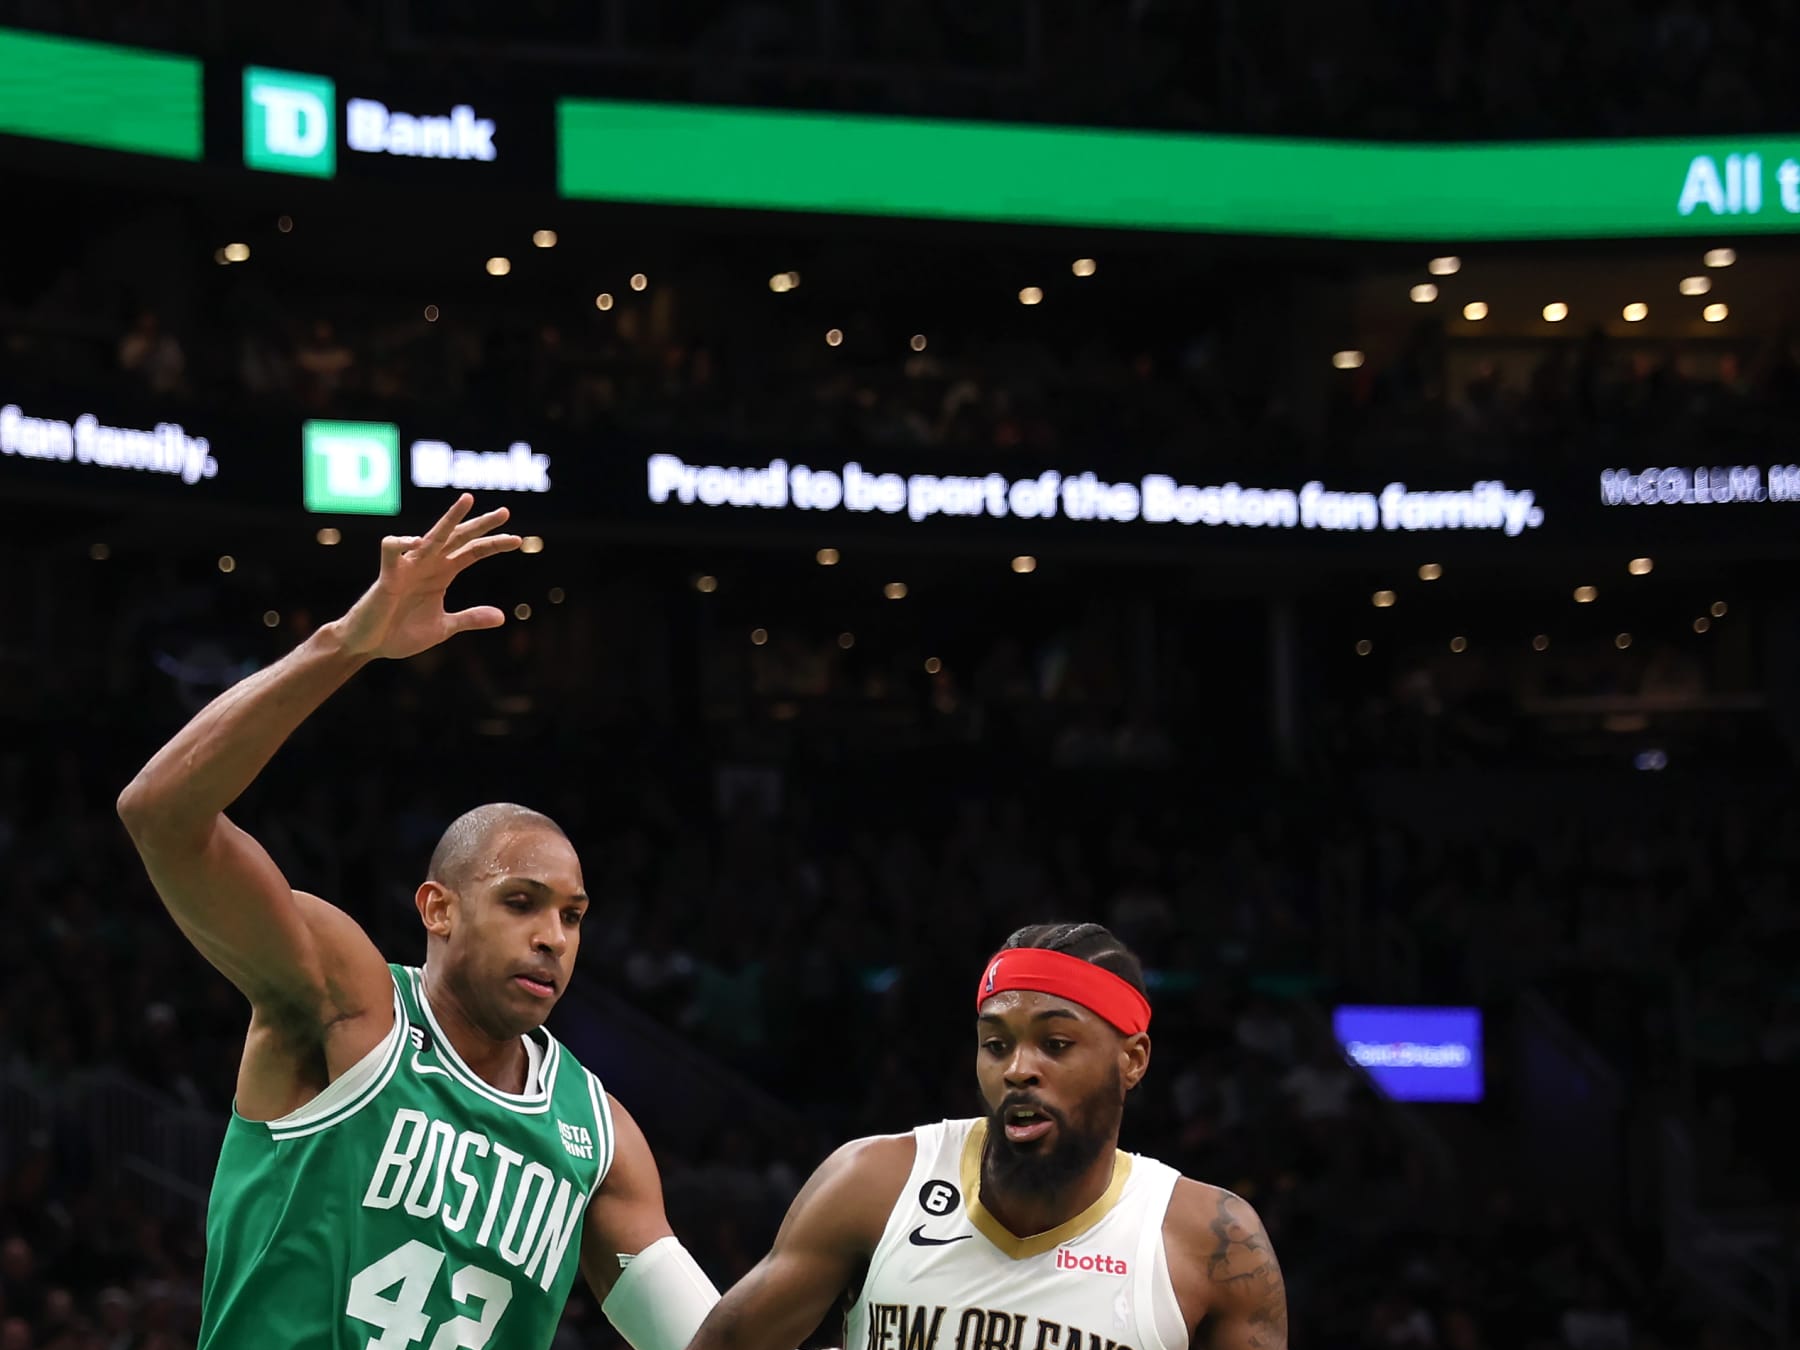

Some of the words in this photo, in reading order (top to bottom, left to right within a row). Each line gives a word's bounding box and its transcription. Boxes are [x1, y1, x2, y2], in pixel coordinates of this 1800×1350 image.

[251, 85, 328, 158] TD
[347, 97, 497, 162] Bank
[1678, 151, 1761, 216] All
[0, 404, 73, 462] fan
[310, 437, 393, 498] TD
[411, 439, 551, 493] Bank
[648, 453, 789, 509] Proud
[790, 464, 842, 511] to
[843, 461, 906, 514] be
[907, 472, 1009, 522] part
[1009, 469, 1061, 519] of
[1062, 471, 1140, 522] the
[1141, 474, 1299, 528] Boston
[1300, 480, 1379, 532] fan
[362, 1108, 586, 1293] BOSTON
[926, 1184, 953, 1213] 6
[1056, 1248, 1127, 1275] ibotta
